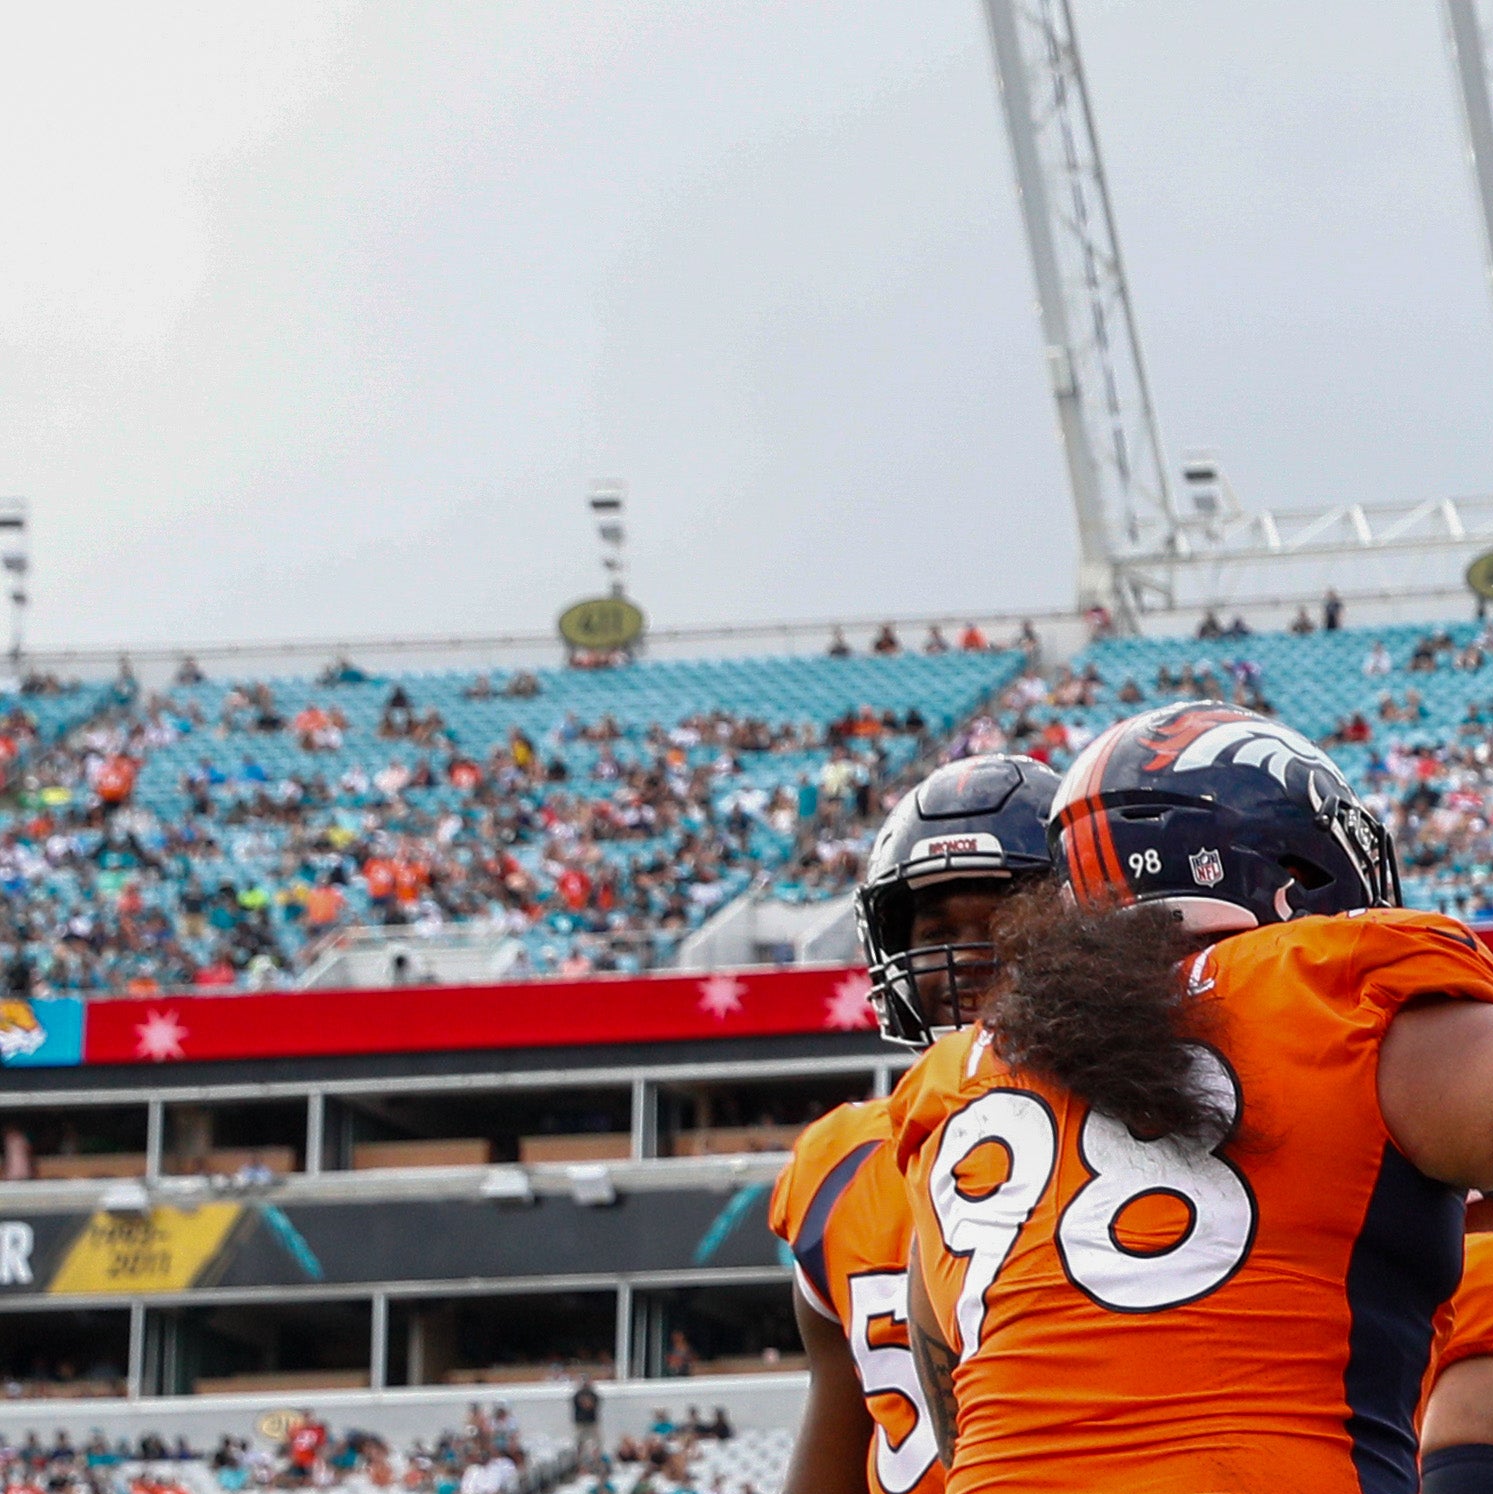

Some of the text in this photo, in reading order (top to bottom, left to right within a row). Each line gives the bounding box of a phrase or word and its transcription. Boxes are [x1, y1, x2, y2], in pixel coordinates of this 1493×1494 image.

[1128, 848, 1162, 879] 98
[1195, 864, 1220, 883] NFL
[929, 1039, 1258, 1363] 98
